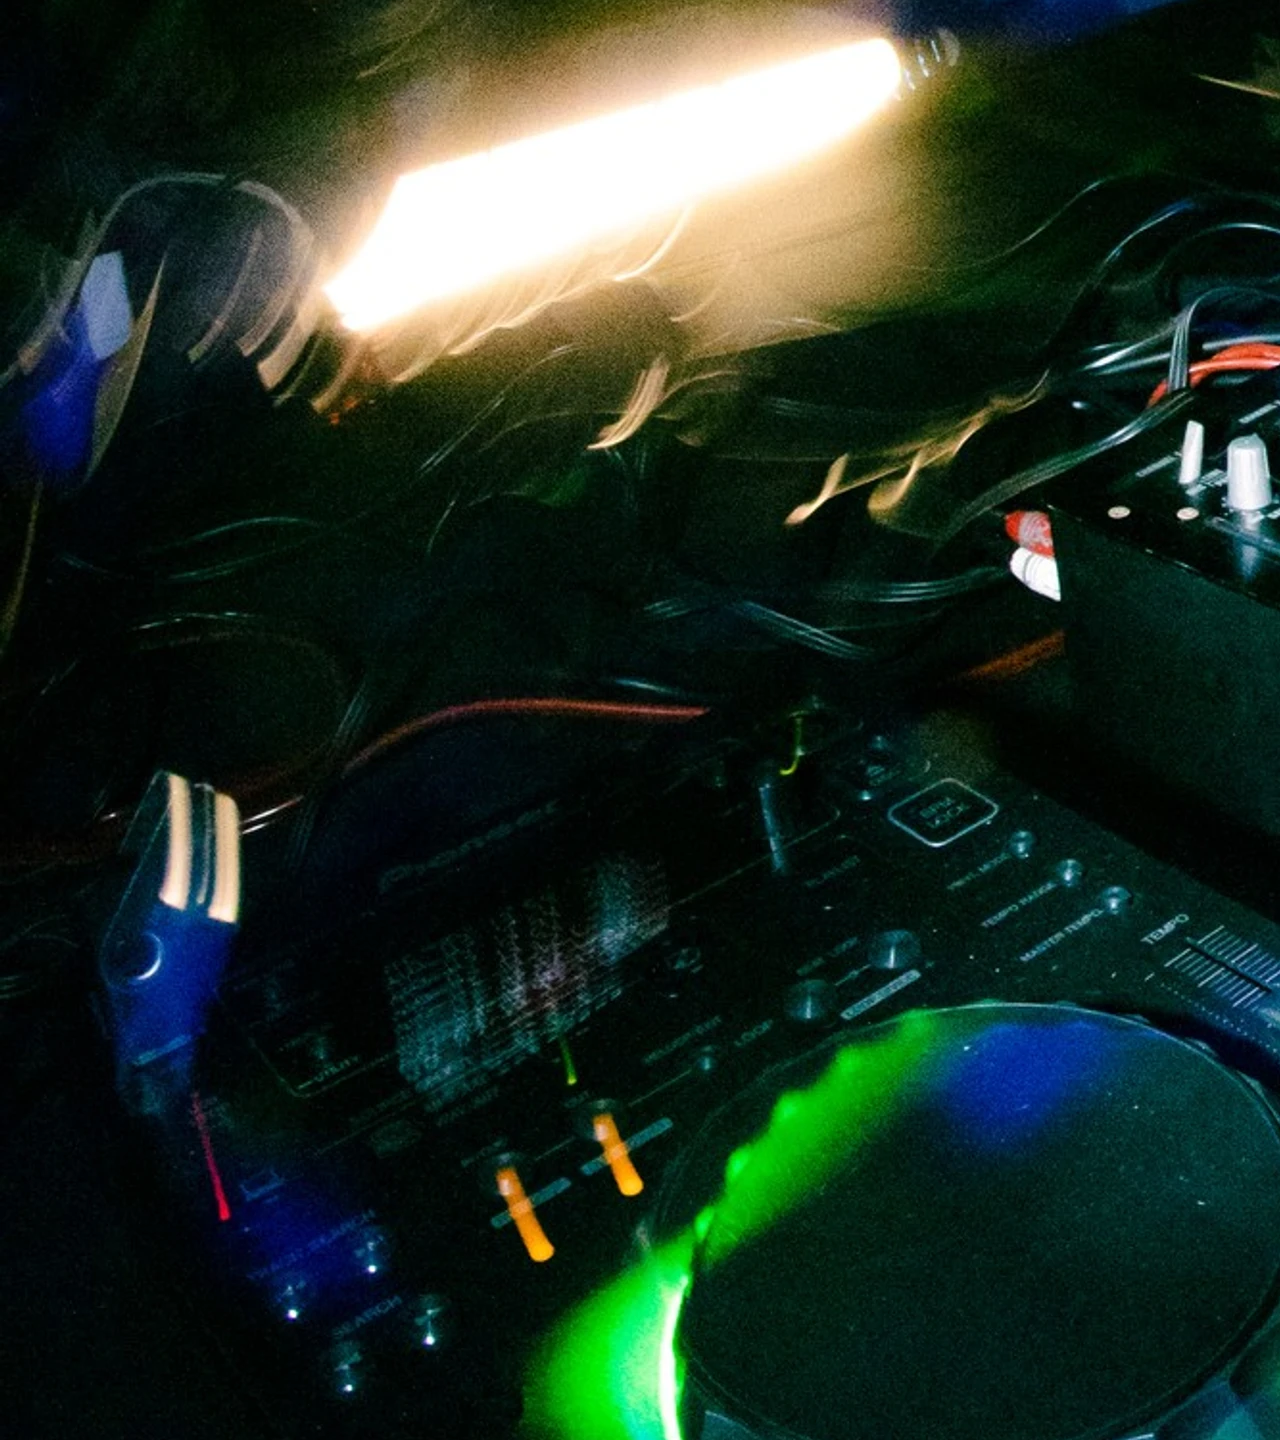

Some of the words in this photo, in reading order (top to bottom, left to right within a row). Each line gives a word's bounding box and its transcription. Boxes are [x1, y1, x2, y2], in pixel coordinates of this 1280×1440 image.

[1019, 931, 1066, 963] MASTER
[1064, 908, 1104, 934] TEMPO
[1140, 913, 1190, 945] TEMPO
